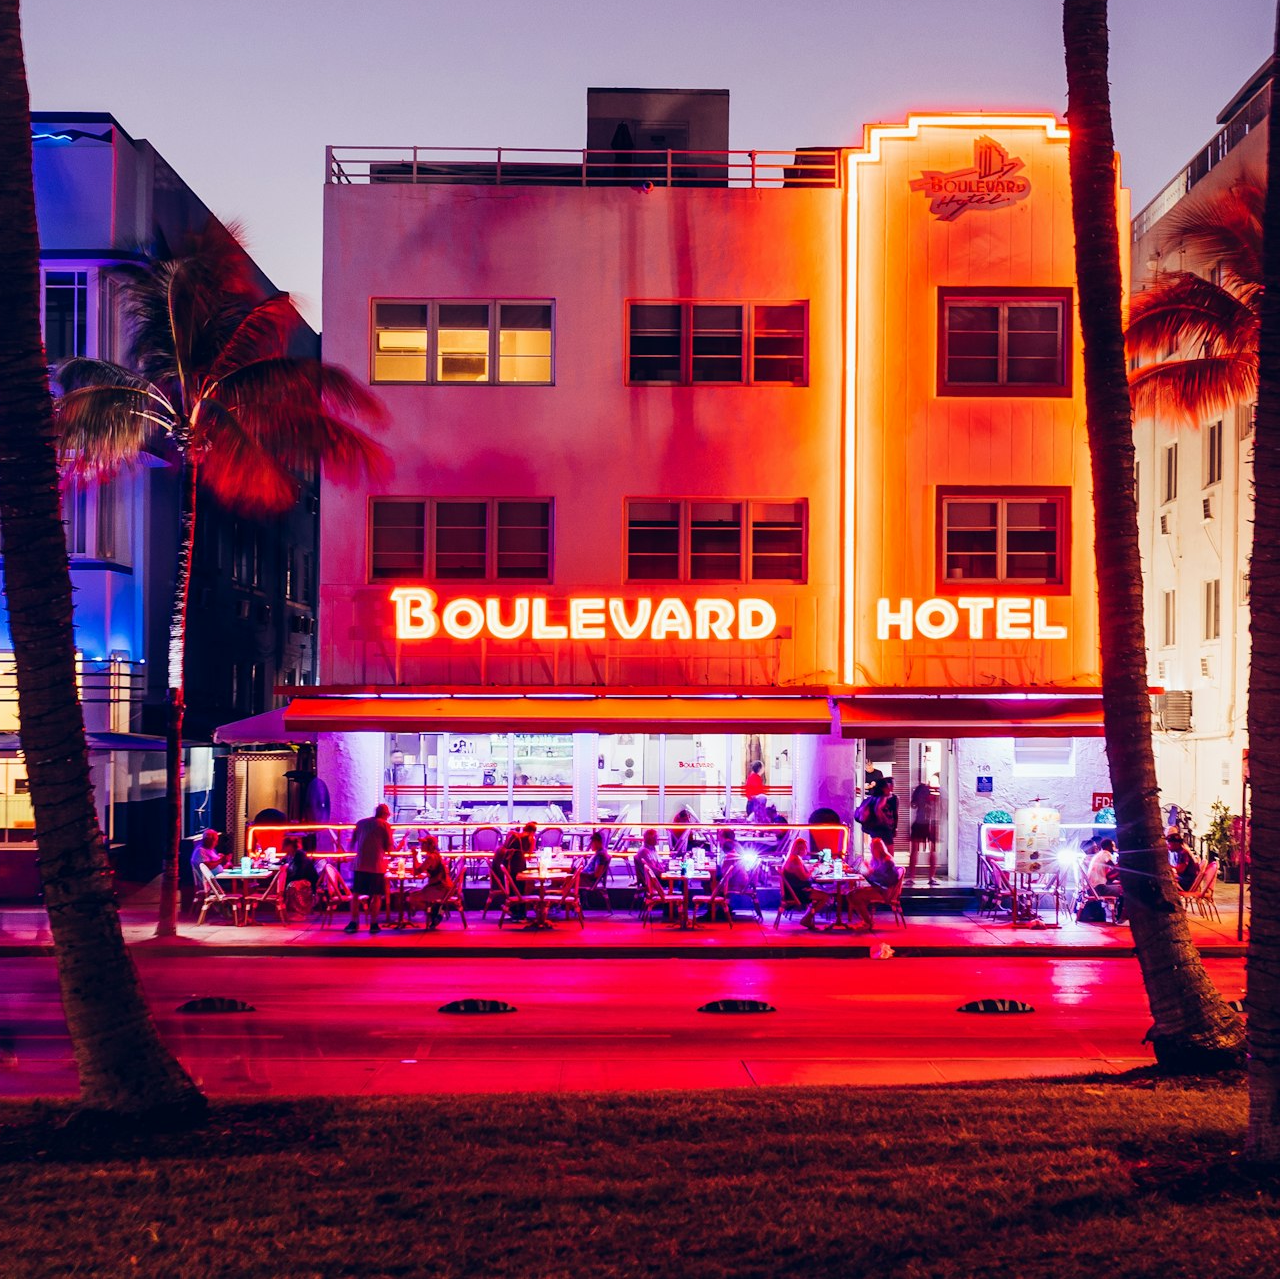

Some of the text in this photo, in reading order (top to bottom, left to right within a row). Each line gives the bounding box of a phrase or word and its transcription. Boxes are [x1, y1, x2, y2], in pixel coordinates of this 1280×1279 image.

[931, 177, 1026, 193] BOULEVARD
[937, 193, 1010, 208] Hotel
[390, 586, 1068, 640] BOULEVARD HOTEL
